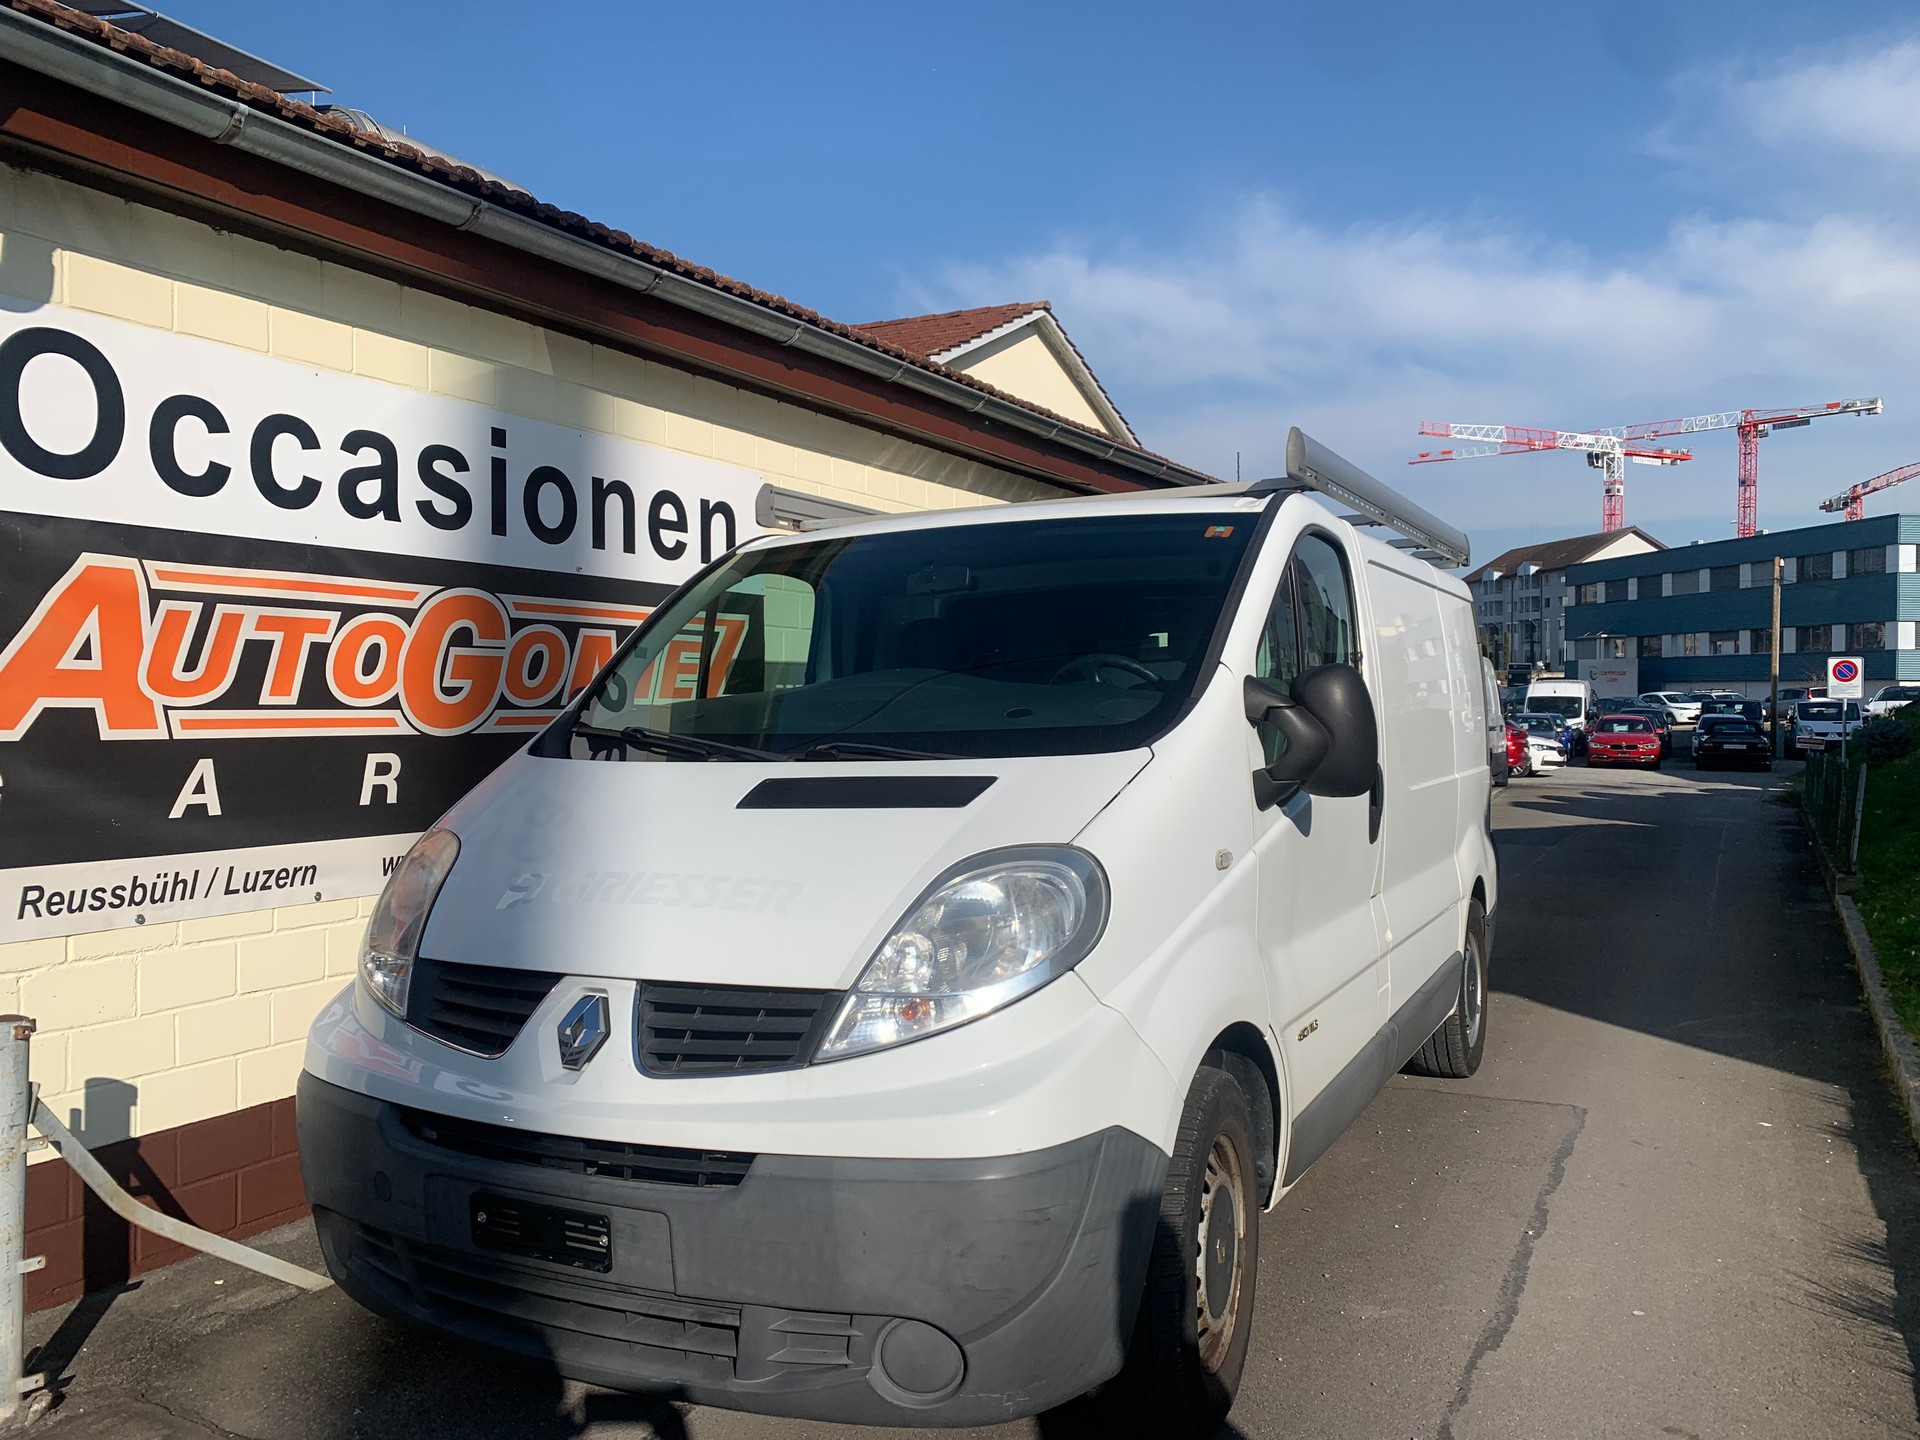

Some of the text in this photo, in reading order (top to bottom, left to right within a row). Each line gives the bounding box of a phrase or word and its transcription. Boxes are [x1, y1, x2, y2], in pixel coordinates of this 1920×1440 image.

[0, 327, 736, 564] Occasionen
[17, 870, 200, 920] Reussbühl
[223, 864, 318, 896] Luzern
